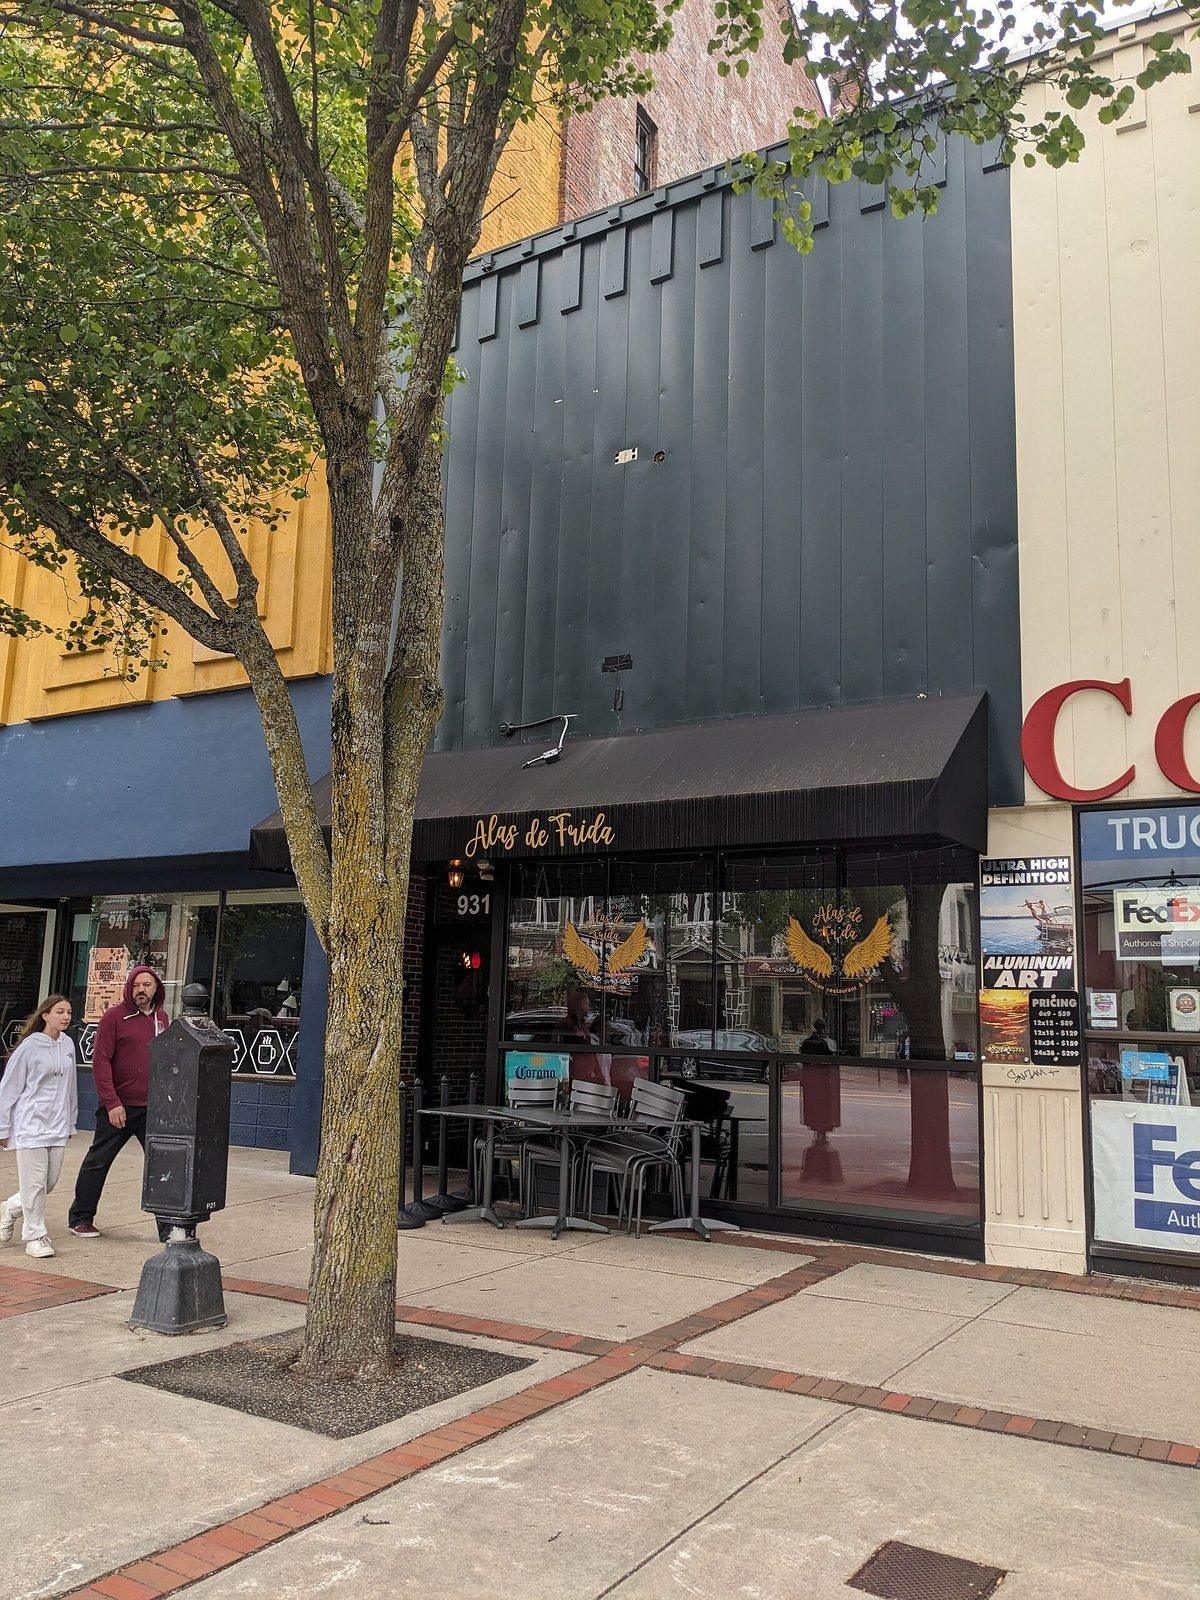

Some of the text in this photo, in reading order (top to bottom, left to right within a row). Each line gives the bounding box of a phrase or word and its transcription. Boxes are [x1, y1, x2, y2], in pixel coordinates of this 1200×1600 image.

[465, 812, 615, 858] Alas de Frida
[982, 858, 1069, 872] ULTRA HIGH
[982, 871, 1069, 885] DEFINITION
[457, 894, 490, 915] 931
[812, 903, 864, 926] Alas de
[108, 914, 129, 930] 941
[1123, 939, 1166, 948] Authorized
[984, 955, 1073, 970] ALUMINUM
[993, 970, 1059, 989] ART
[1032, 998, 1078, 1008] PRICING
[1060, 1029, 1078, 1037] $129
[1061, 1039, 1079, 1047] $159
[1061, 1049, 1080, 1057] $299
[515, 1064, 557, 1080] Corona
